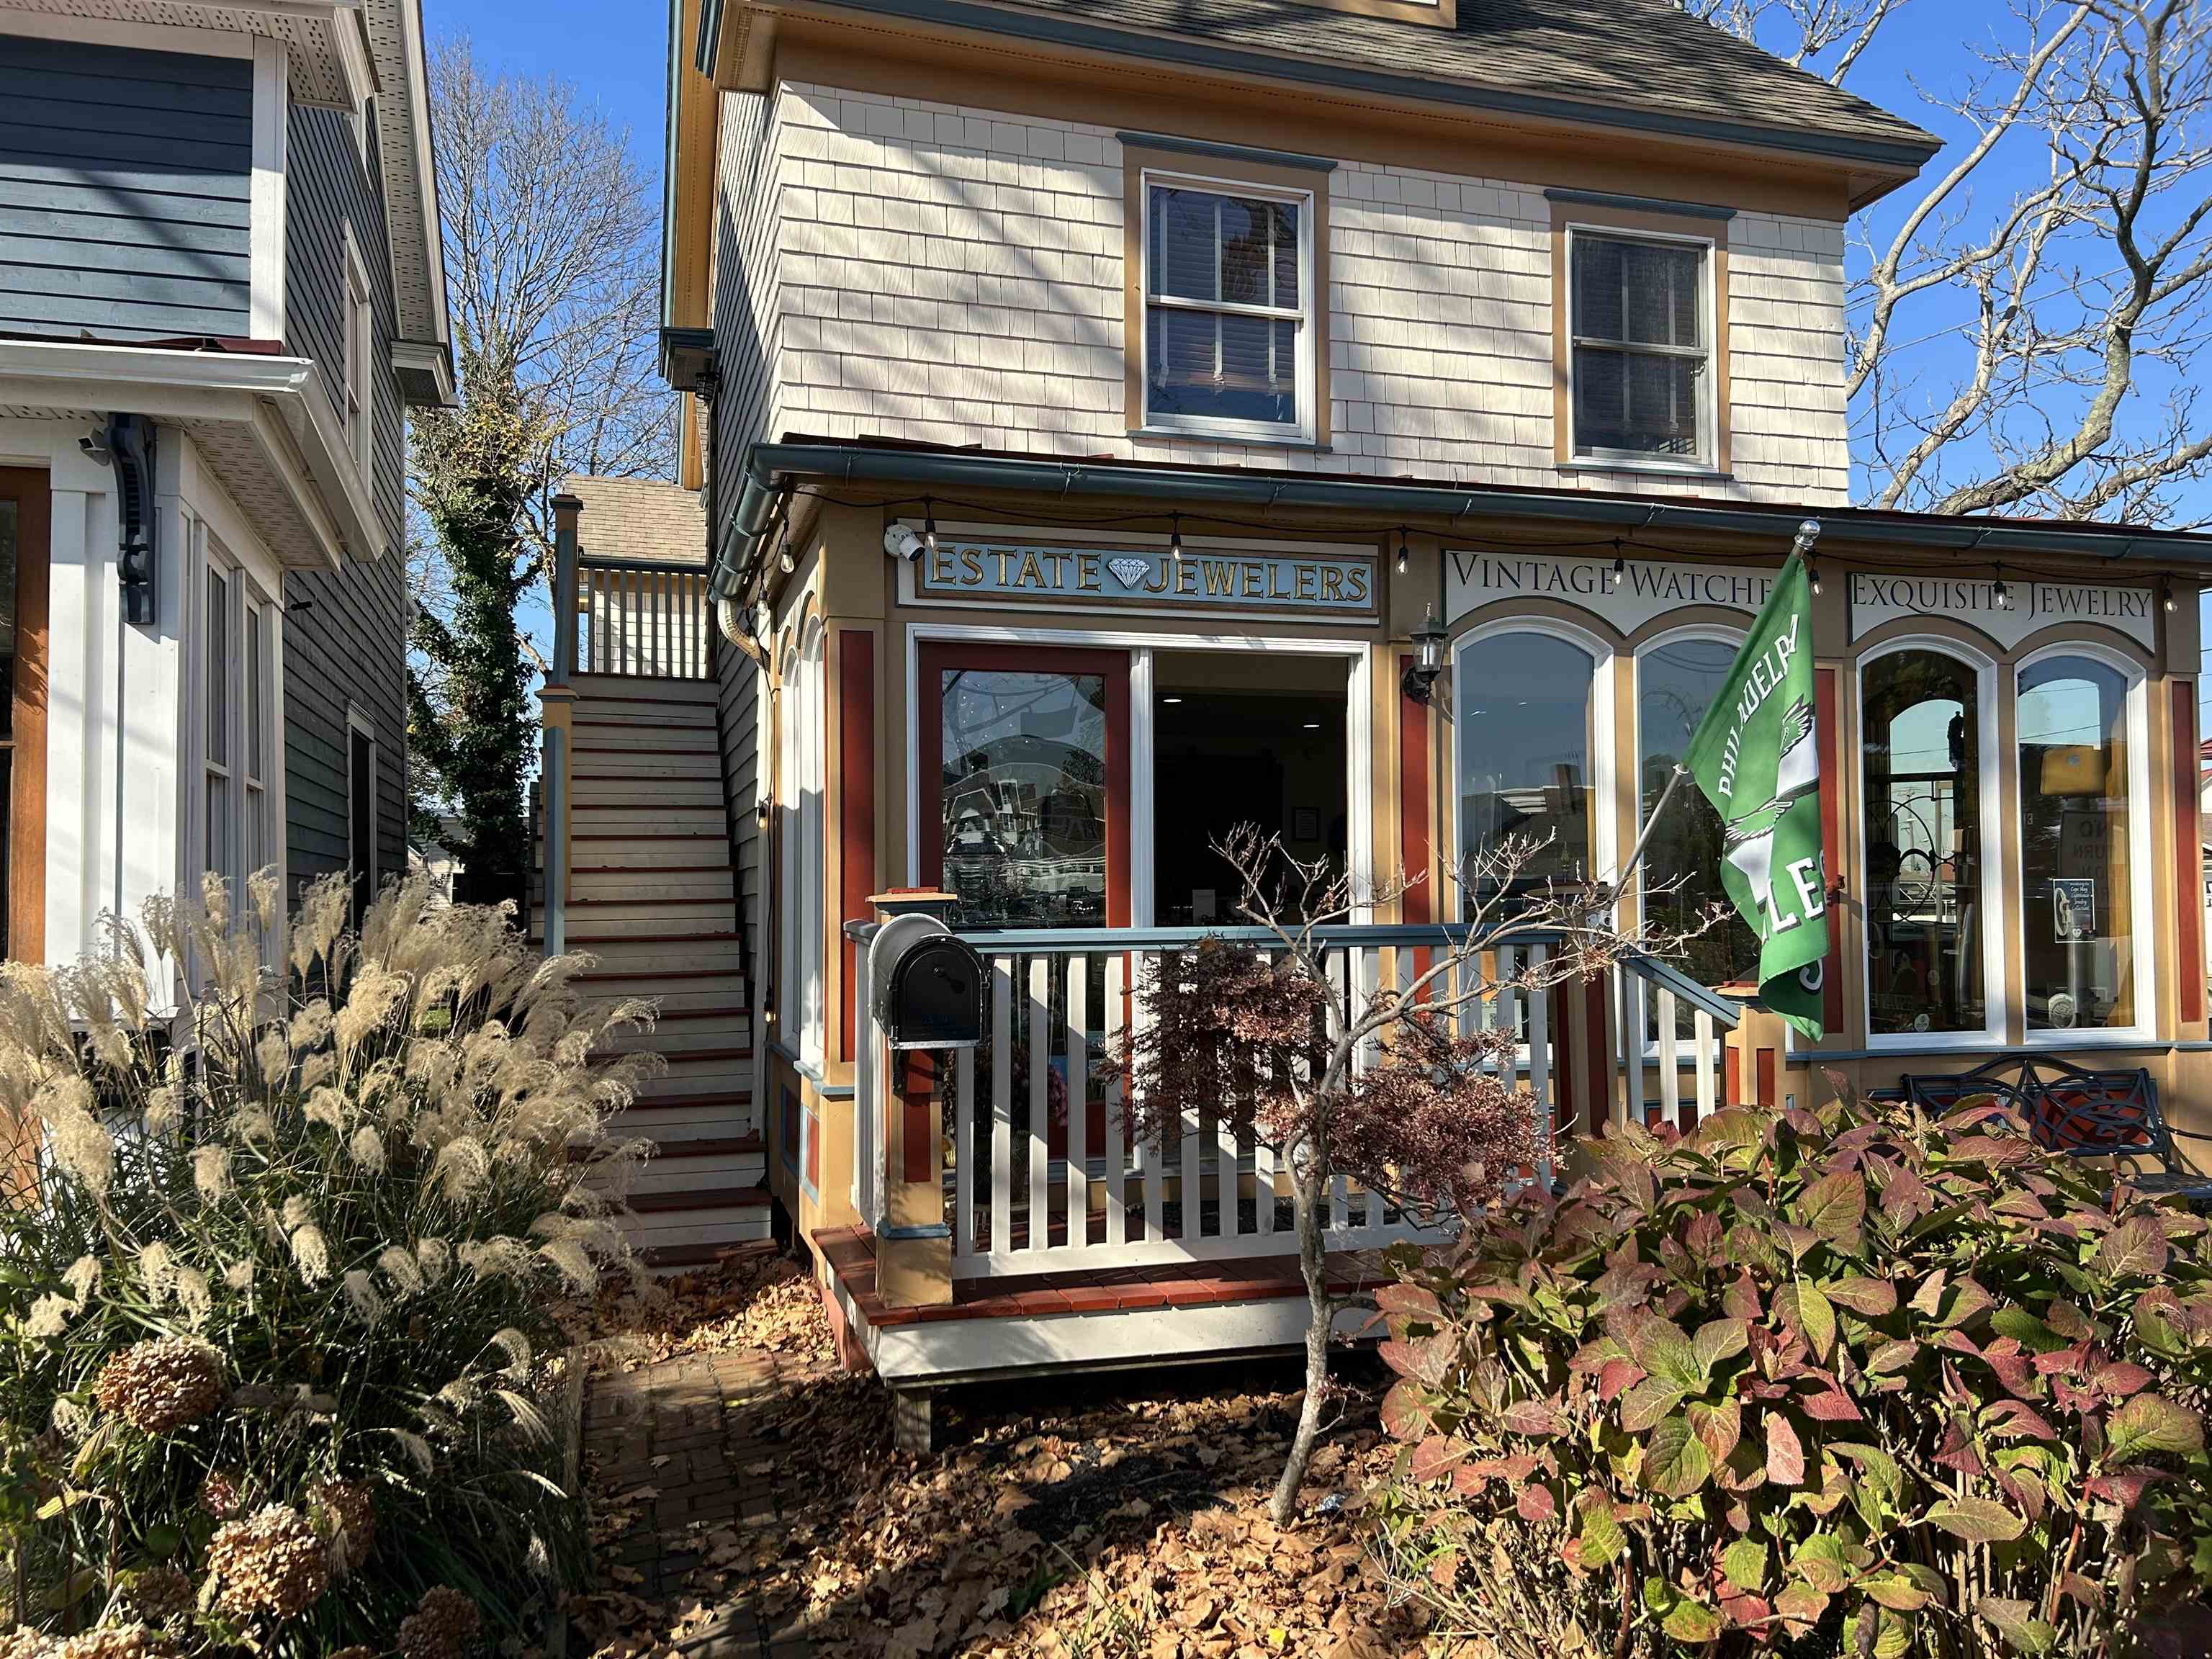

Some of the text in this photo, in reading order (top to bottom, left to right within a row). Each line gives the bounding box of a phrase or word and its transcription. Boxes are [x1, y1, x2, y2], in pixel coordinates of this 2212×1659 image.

[931, 546, 1367, 603] ESTATE JEWELERS
[1449, 552, 1773, 606] VINTAGE WATCHE
[1851, 574, 2153, 621] EXQUISITE JEWELRY
